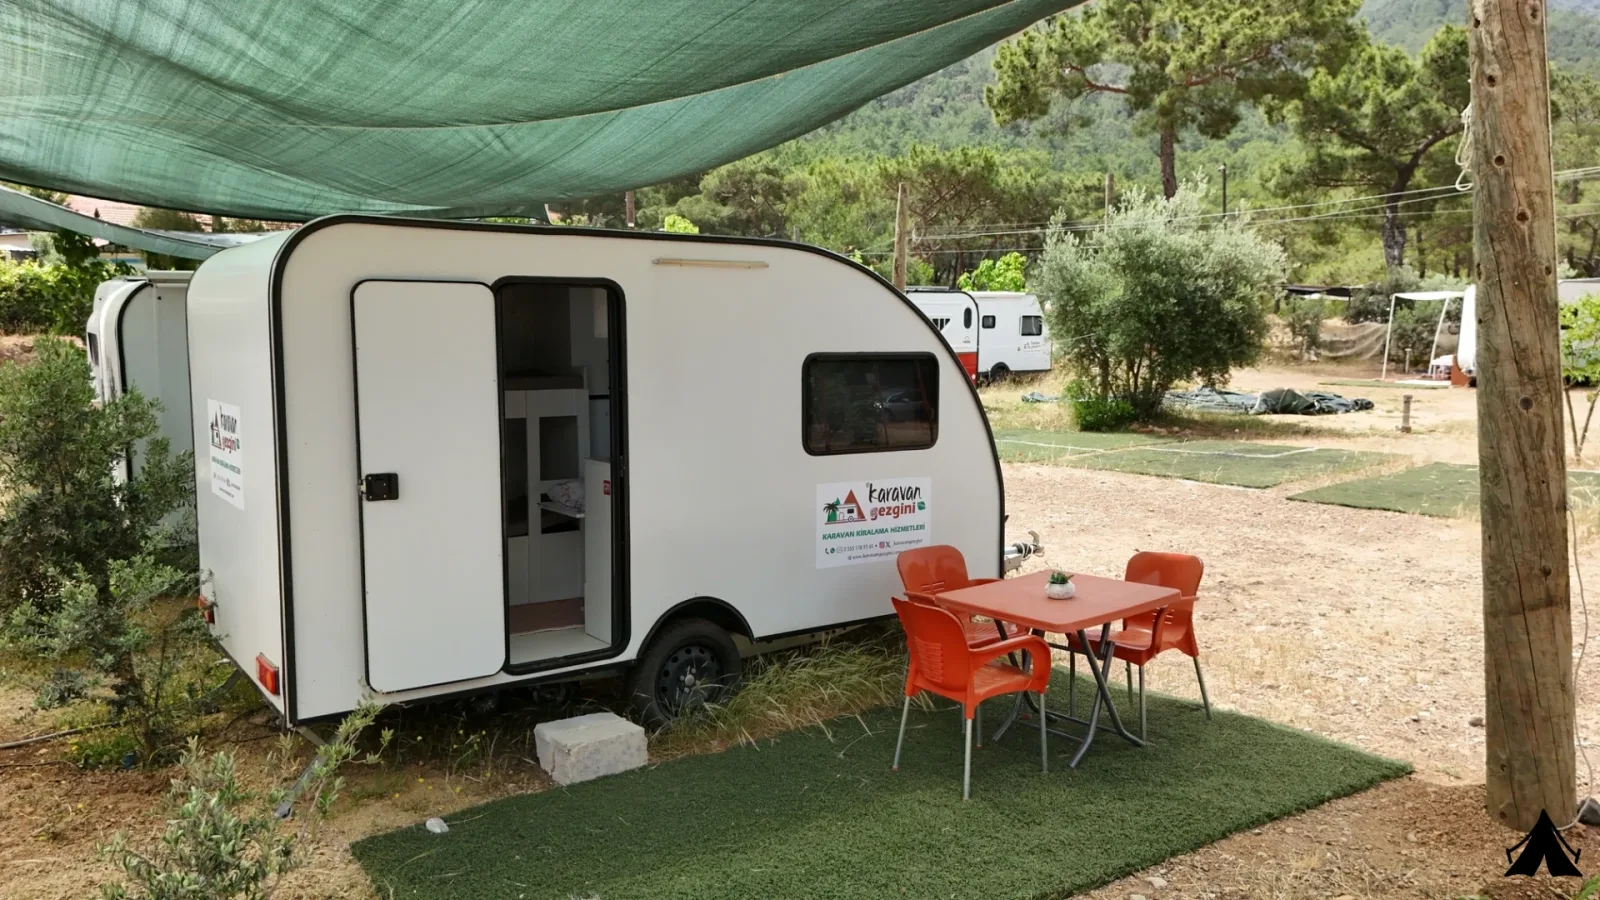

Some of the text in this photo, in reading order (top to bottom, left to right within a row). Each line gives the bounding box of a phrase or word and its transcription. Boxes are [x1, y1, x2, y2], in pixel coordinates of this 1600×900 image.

[868, 482, 922, 504] karavan
[869, 501, 916, 521] gezgini
[822, 522, 926, 541] KARAVAN KİRALAMA HİZMETLERİ
